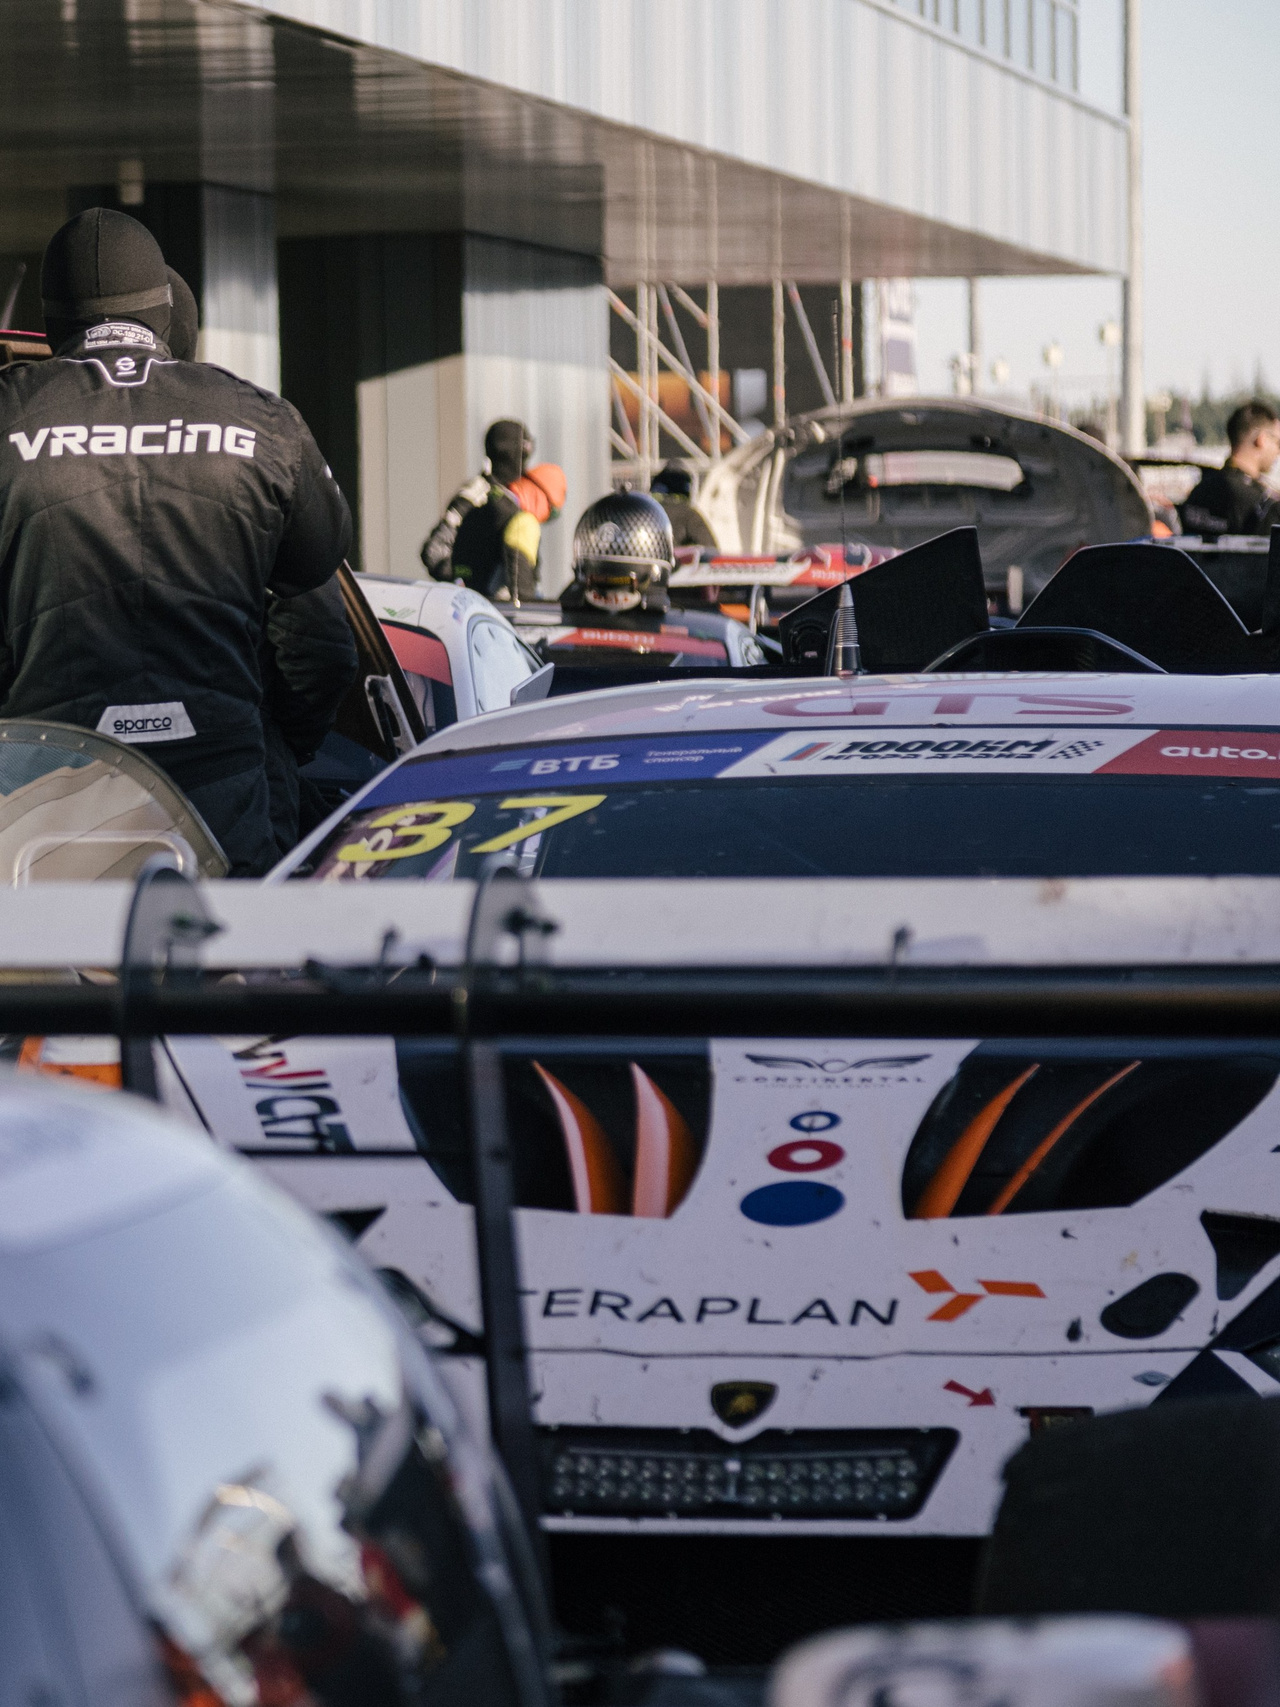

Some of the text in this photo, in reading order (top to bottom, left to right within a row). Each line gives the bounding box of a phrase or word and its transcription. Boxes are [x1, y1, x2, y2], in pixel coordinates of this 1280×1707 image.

[113, 717, 172, 735] sparco
[1160, 745, 1280, 761] auto.
[529, 754, 620, 776] ВТБ
[337, 794, 608, 862] 37
